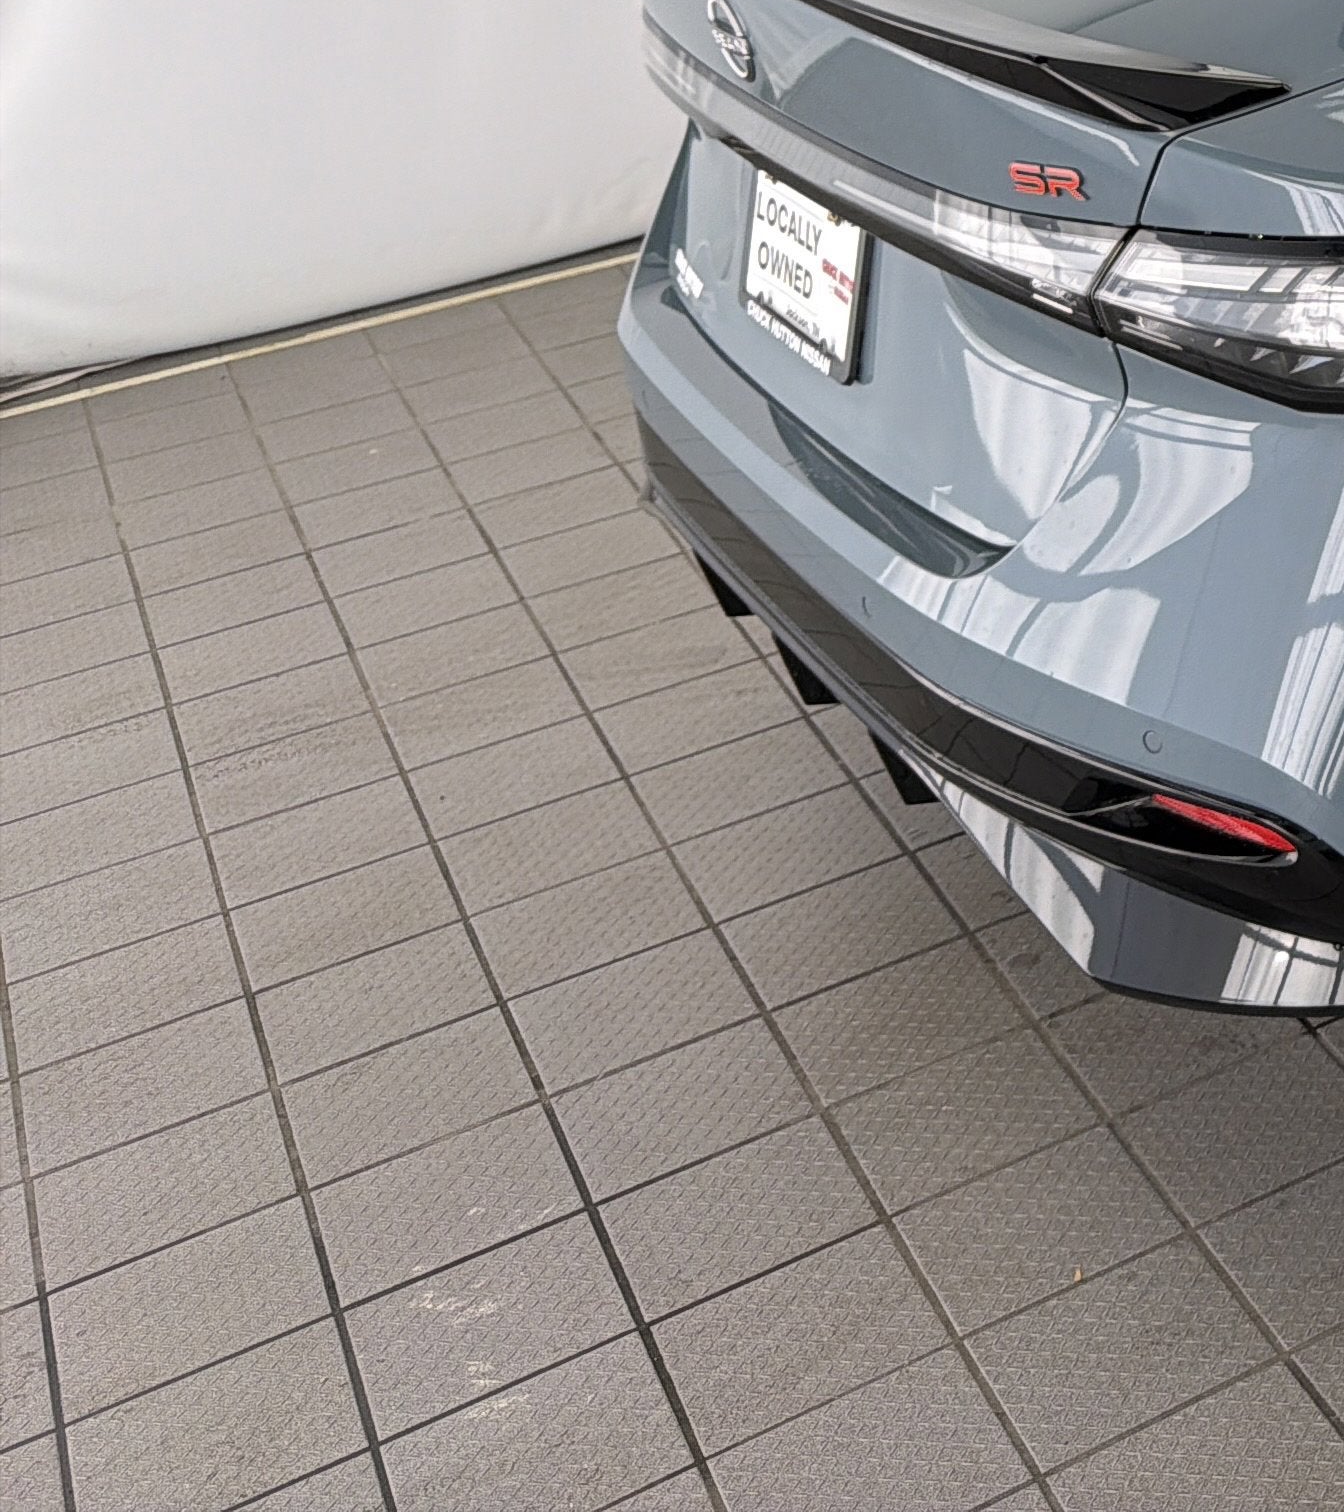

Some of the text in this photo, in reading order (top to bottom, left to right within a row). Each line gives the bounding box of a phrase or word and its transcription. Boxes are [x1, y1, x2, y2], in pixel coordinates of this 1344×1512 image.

[1008, 161, 1088, 201] SR
[756, 191, 822, 256] LOCALLY
[757, 240, 814, 300] OWNED
